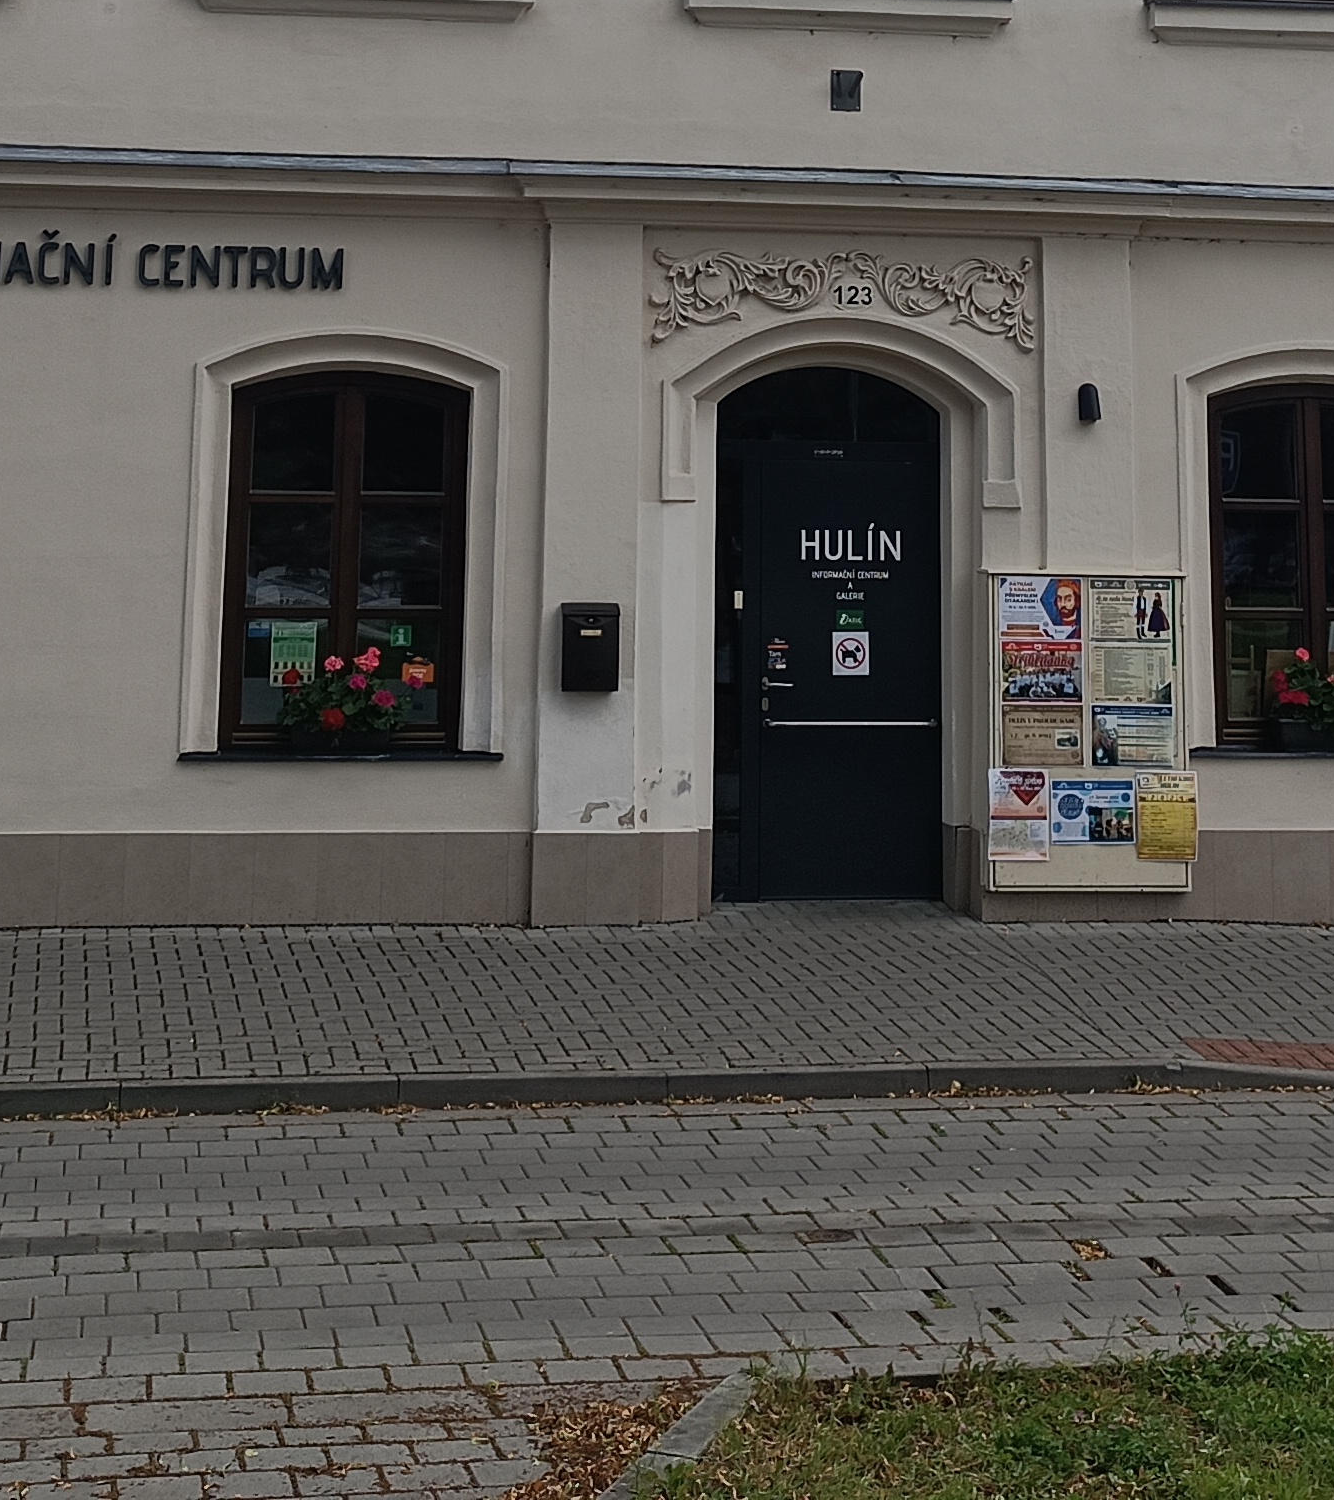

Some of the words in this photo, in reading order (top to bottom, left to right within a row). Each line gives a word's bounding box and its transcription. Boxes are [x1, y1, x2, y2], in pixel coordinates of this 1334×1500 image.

[137, 243, 345, 291] CENTRUM
[833, 285, 873, 306] 123
[800, 522, 901, 562] HULÍN
[811, 569, 855, 579] INFORMAČNÍ
[857, 570, 889, 579] CENTRUM
[847, 581, 853, 590] A
[836, 591, 865, 601] GALERIE
